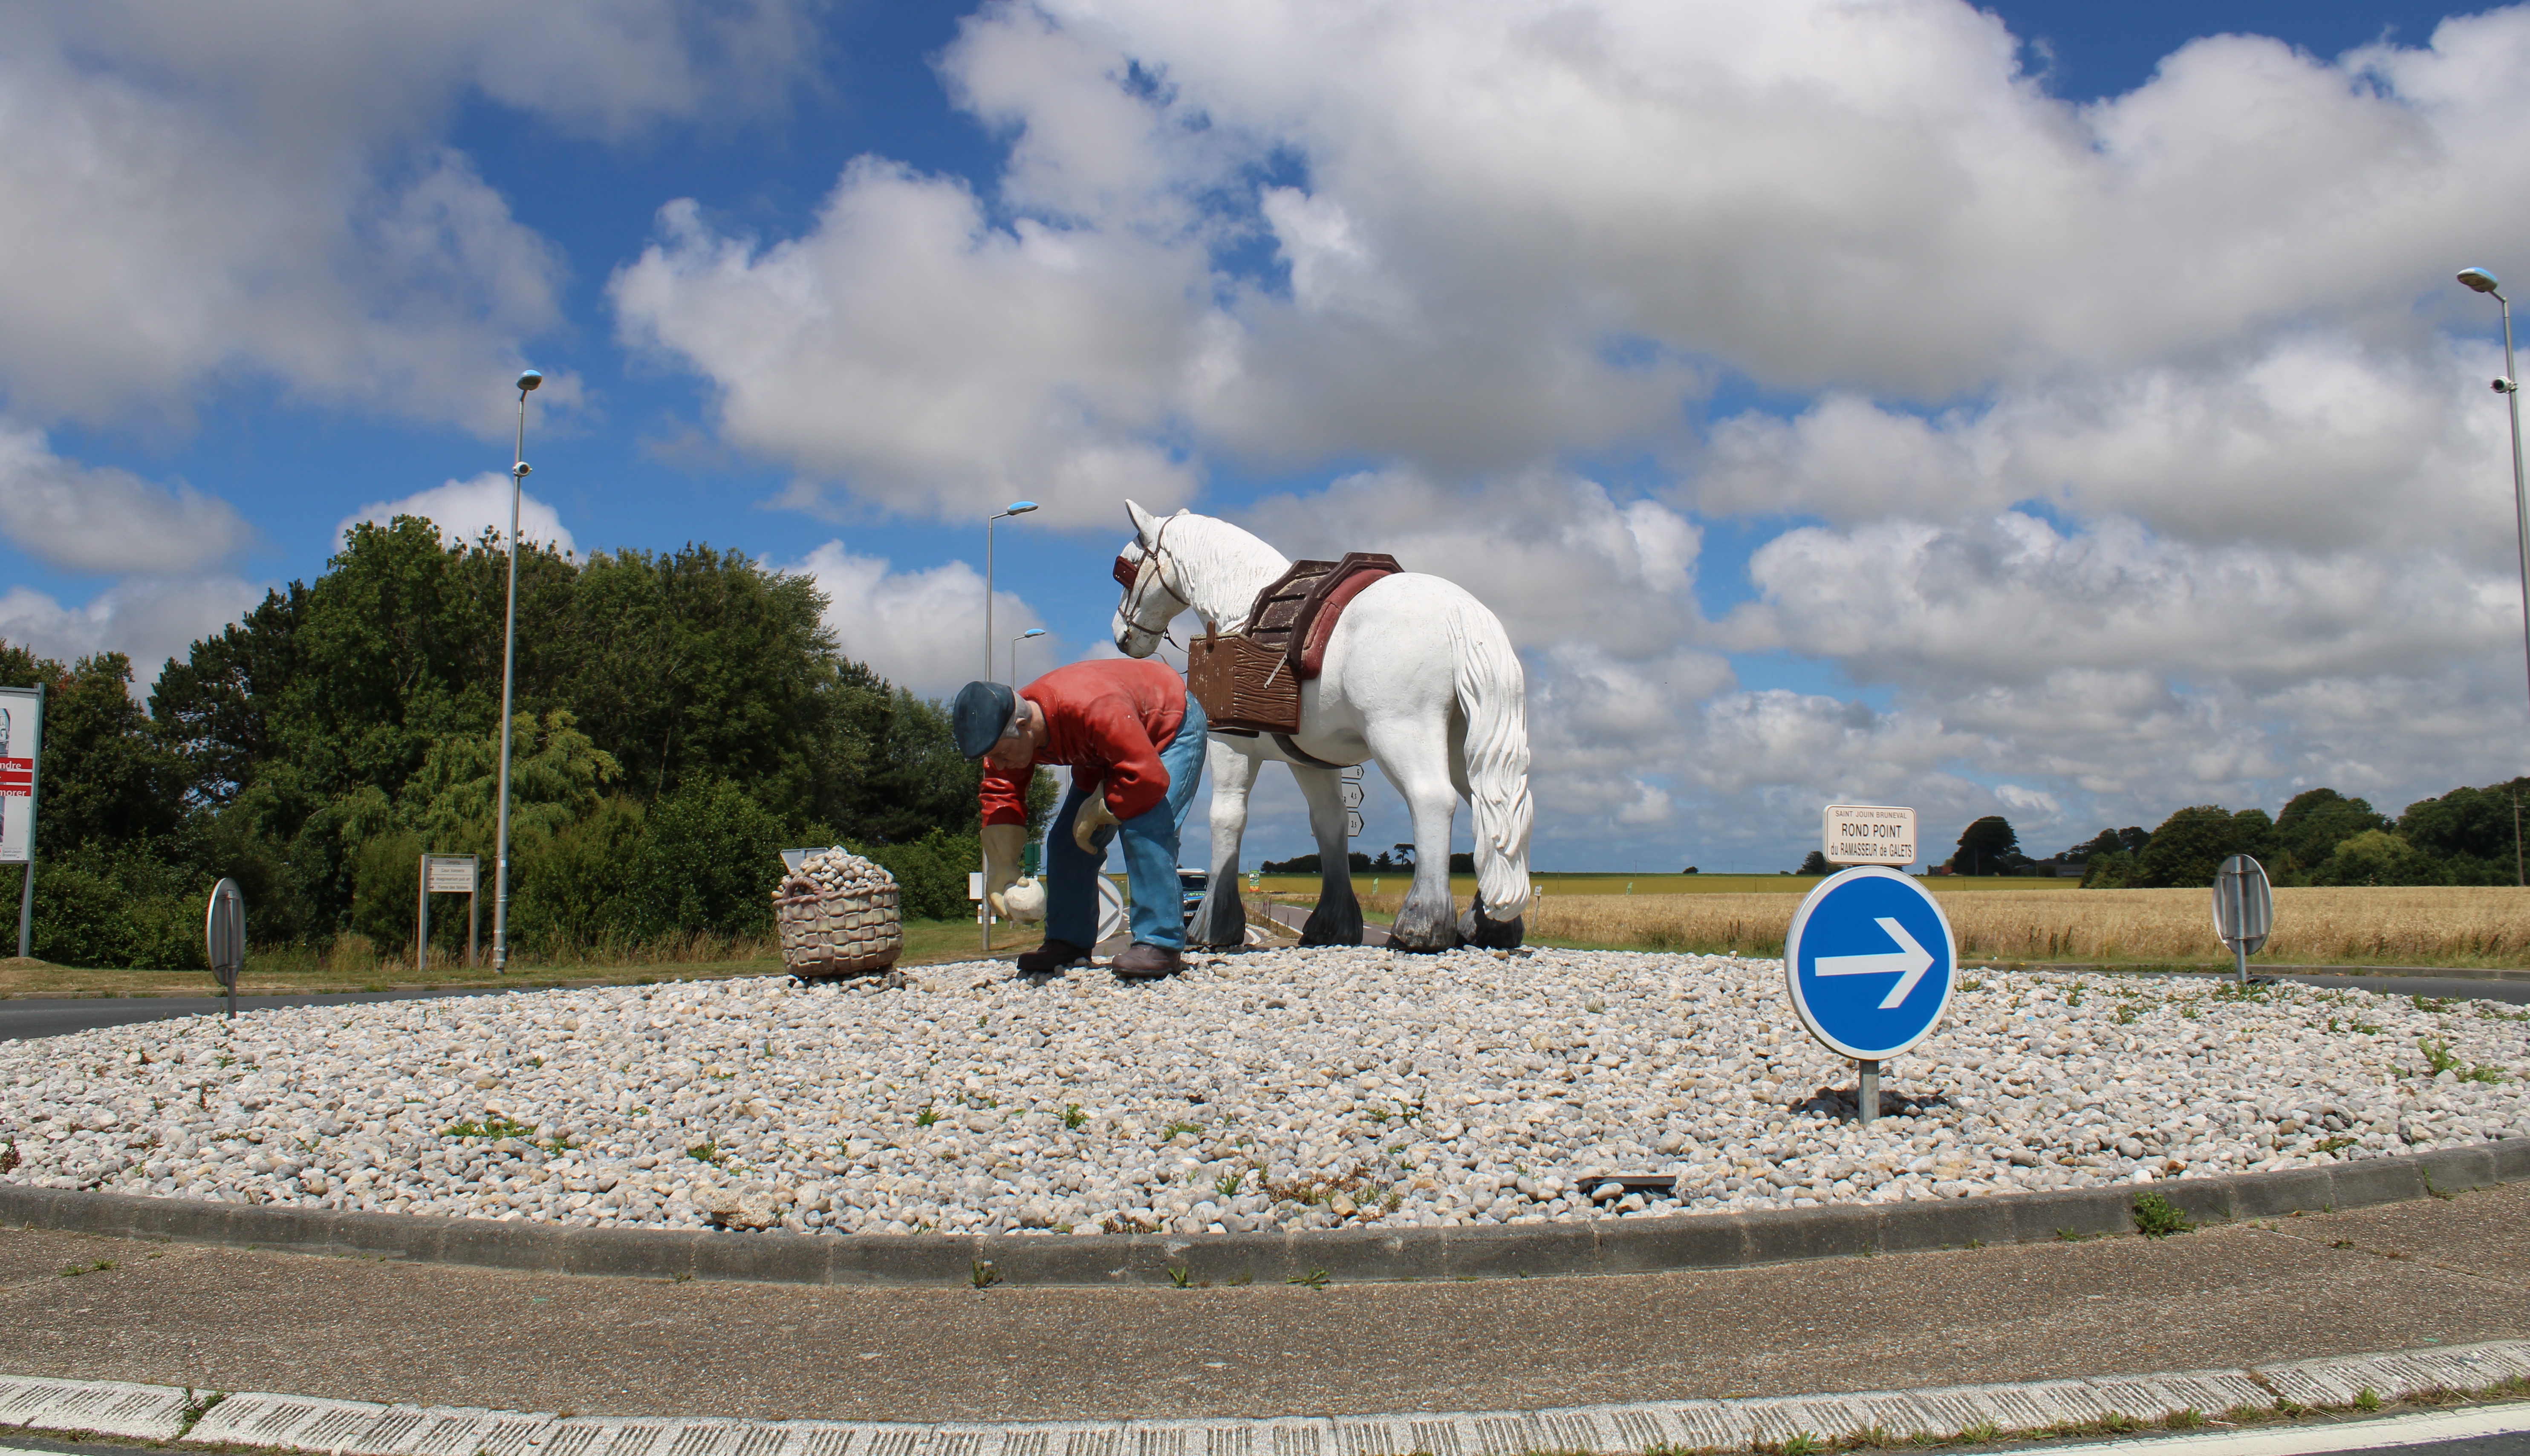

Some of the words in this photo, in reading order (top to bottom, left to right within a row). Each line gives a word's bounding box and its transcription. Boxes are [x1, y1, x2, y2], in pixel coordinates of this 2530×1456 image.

[1841, 823, 1869, 837] ROND
[1873, 824, 1902, 838] POINT
[1830, 842, 1838, 855] du
[1840, 842, 1877, 856] RAMASSEUR
[1880, 844, 1887, 857] de
[1889, 844, 1912, 858] GALETS
